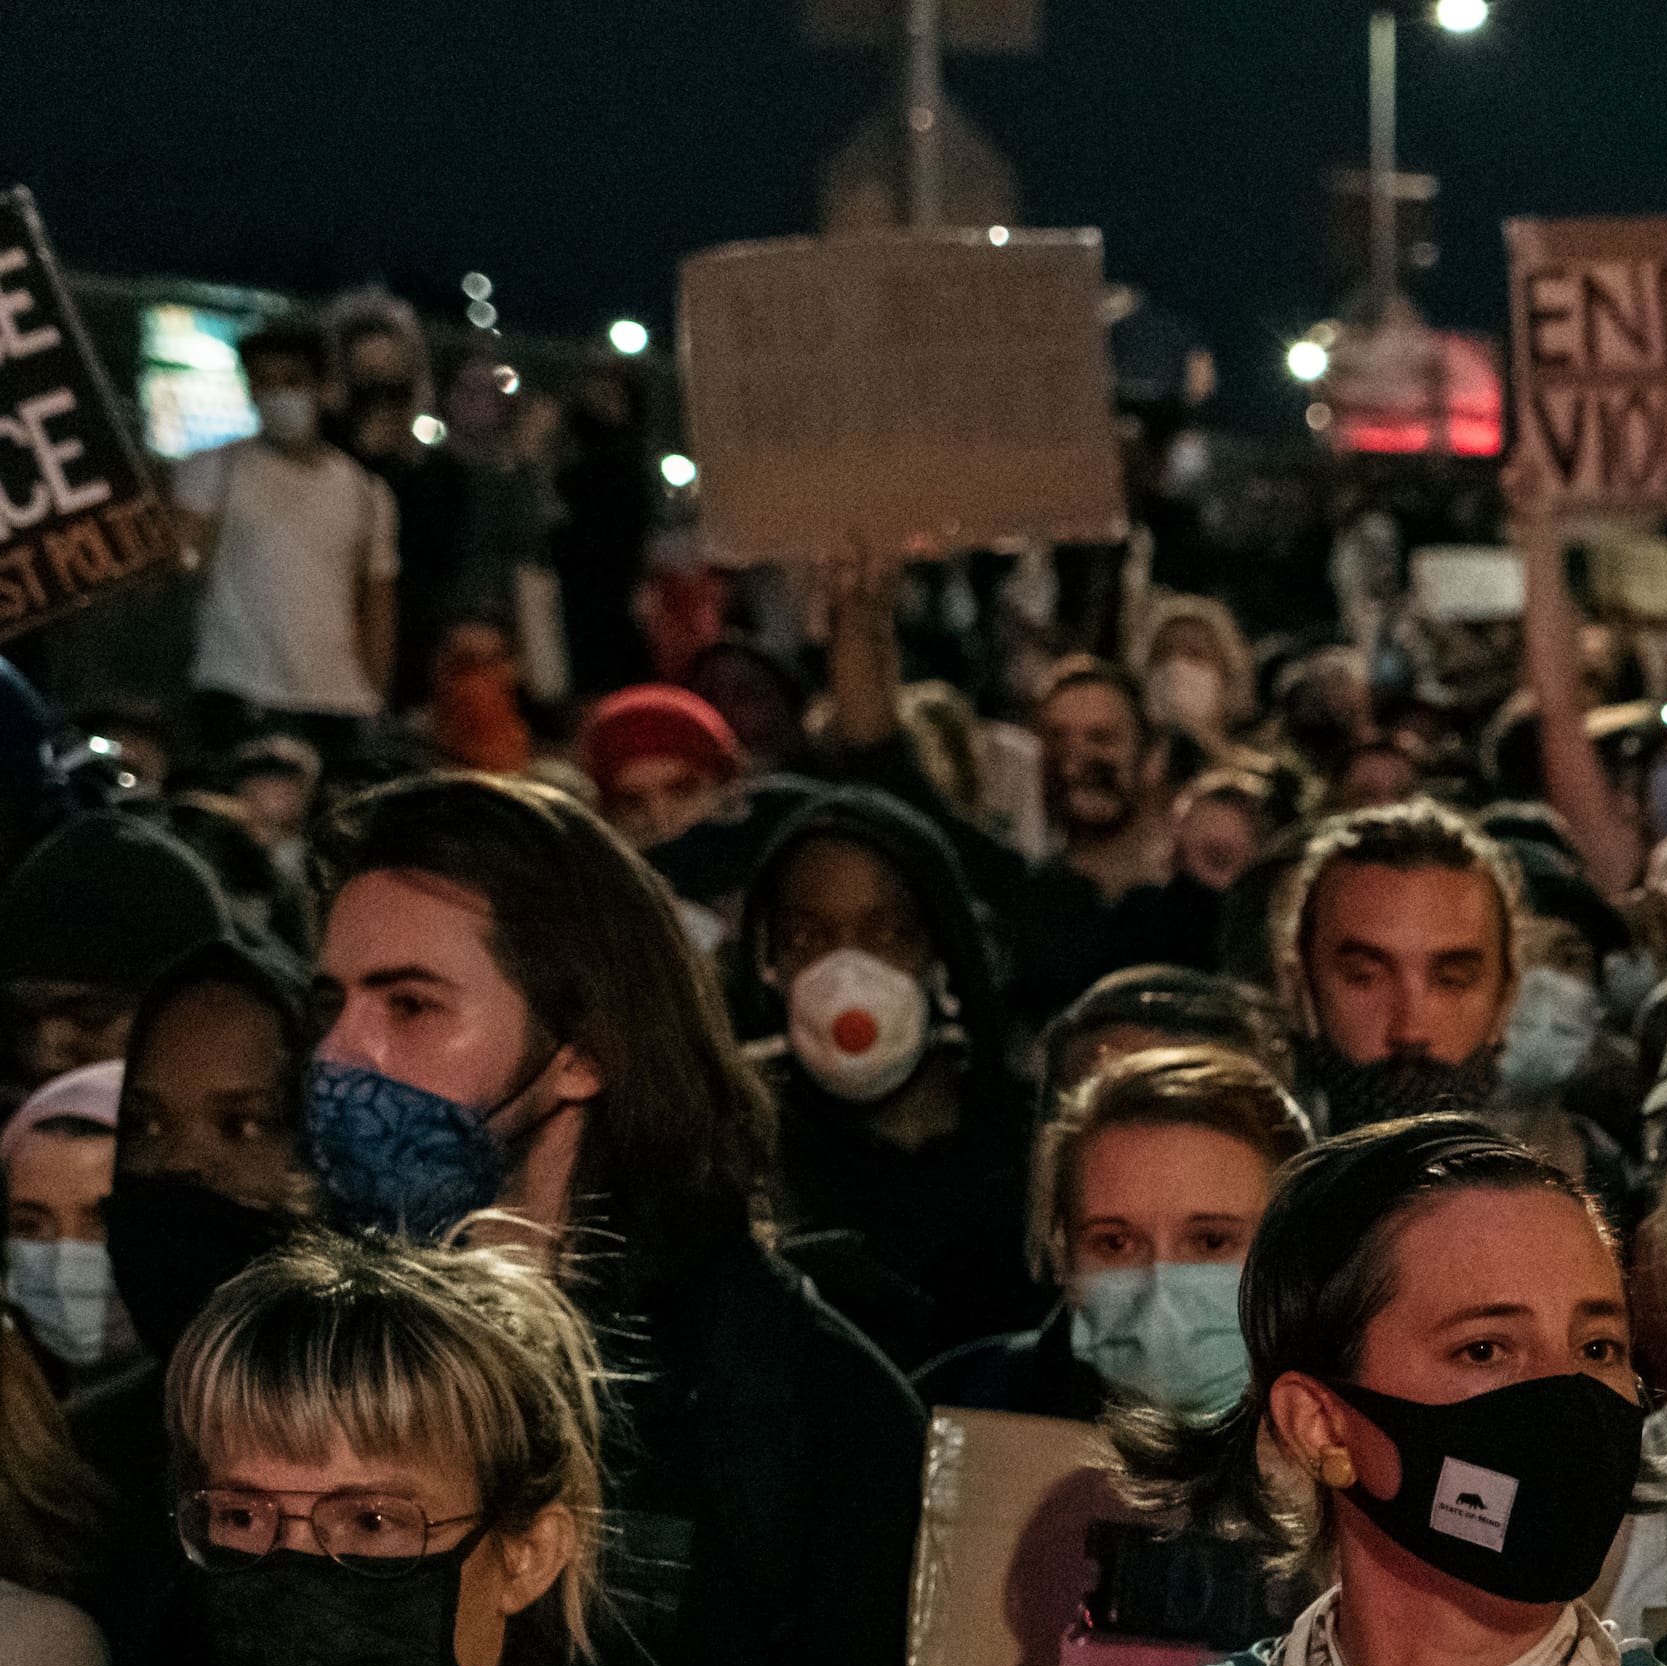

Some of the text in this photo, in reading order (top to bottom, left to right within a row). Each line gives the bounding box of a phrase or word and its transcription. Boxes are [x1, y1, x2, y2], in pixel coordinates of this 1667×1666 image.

[0, 386, 112, 542] CE
[1439, 1502, 1463, 1516] STATE
[1478, 1514, 1501, 1528] MIND
